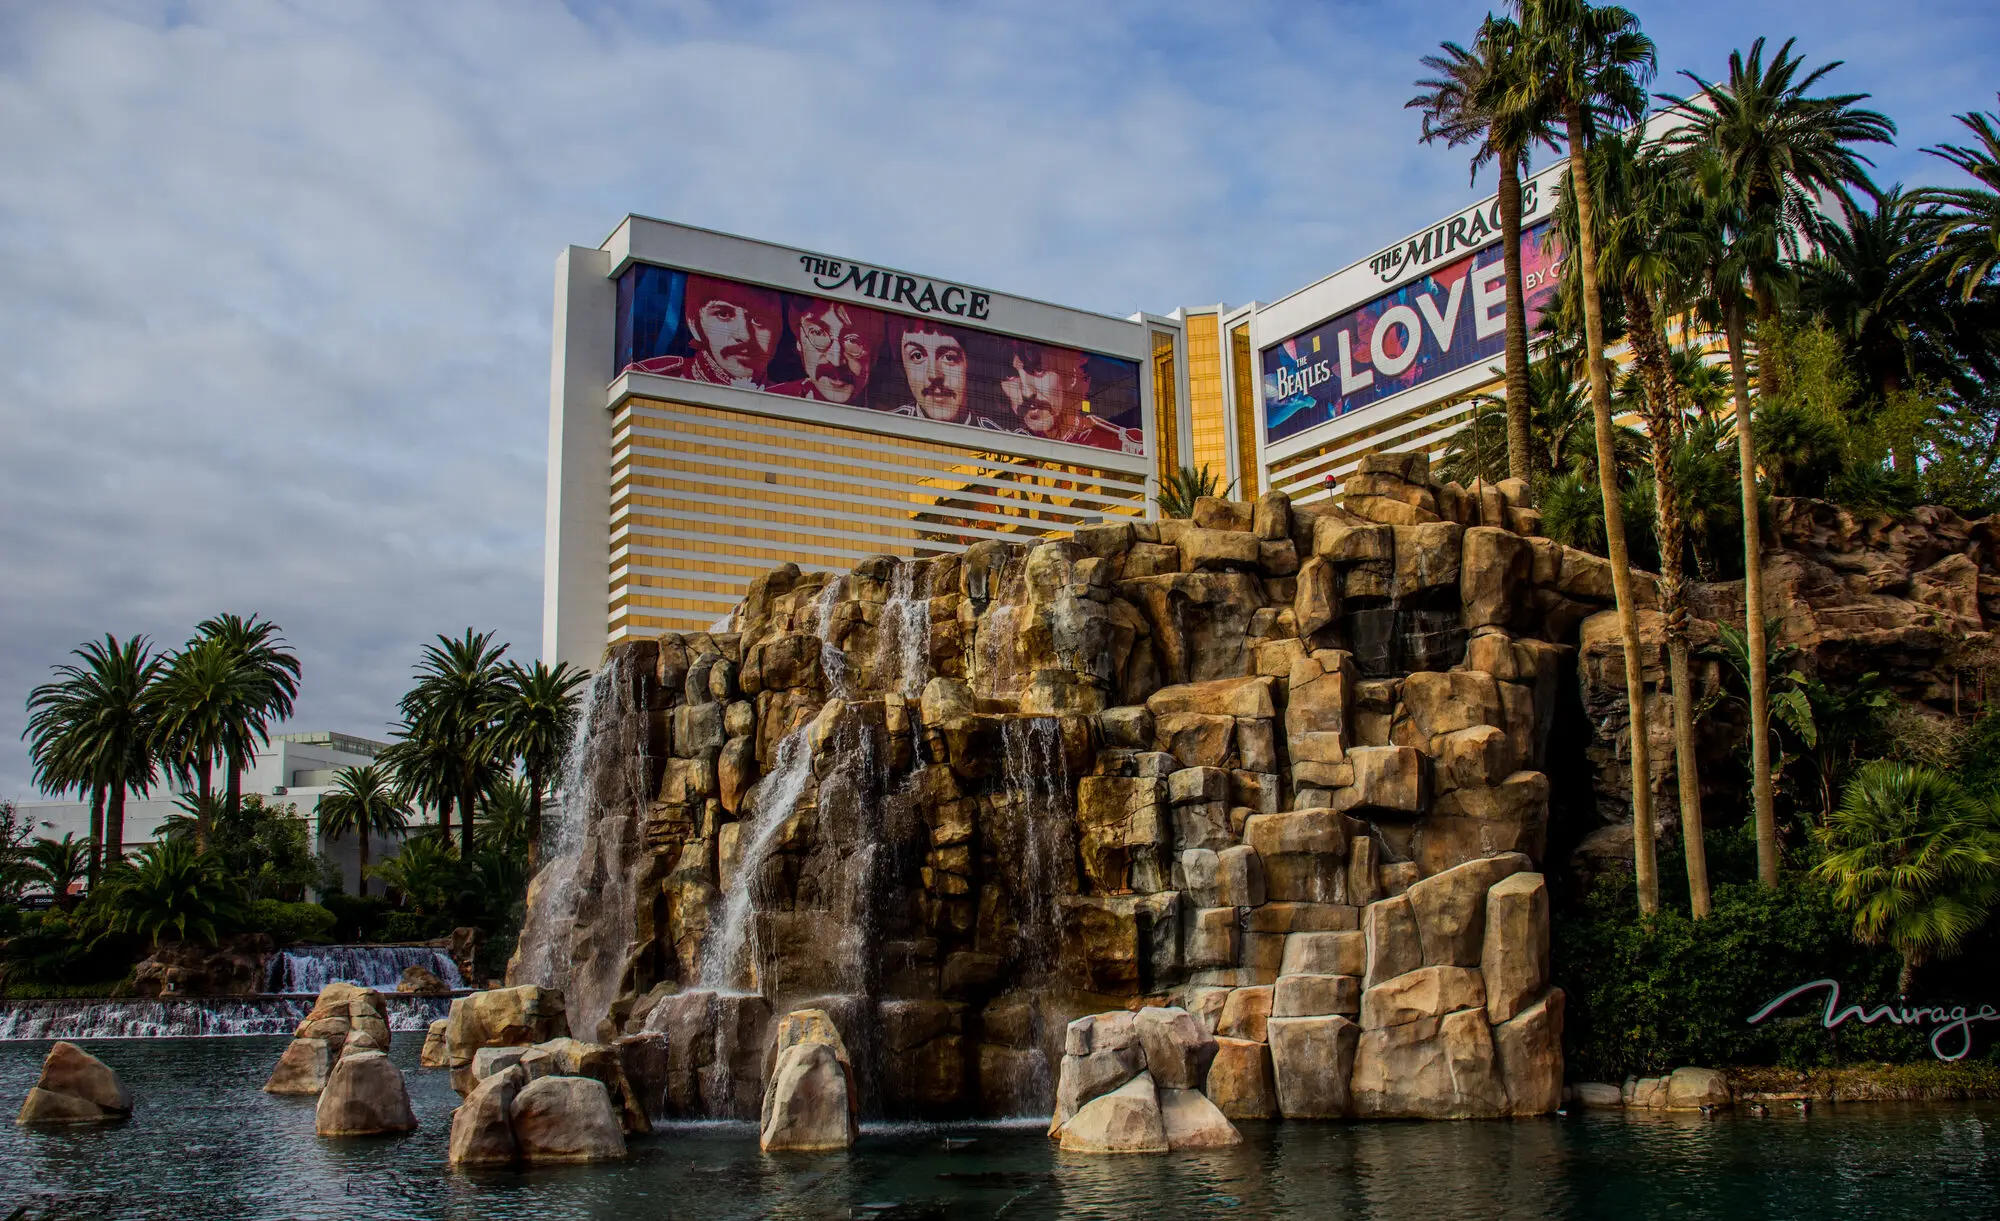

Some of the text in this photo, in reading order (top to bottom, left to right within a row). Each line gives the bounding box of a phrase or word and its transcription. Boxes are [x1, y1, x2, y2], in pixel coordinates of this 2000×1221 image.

[1369, 246, 1402, 275] THE
[800, 255, 991, 321] THE MIRAGE
[1525, 267, 1548, 290] BY
[1337, 257, 1507, 397] LOVE
[1296, 355, 1308, 368] THE
[1276, 359, 1331, 401] BEATLES
